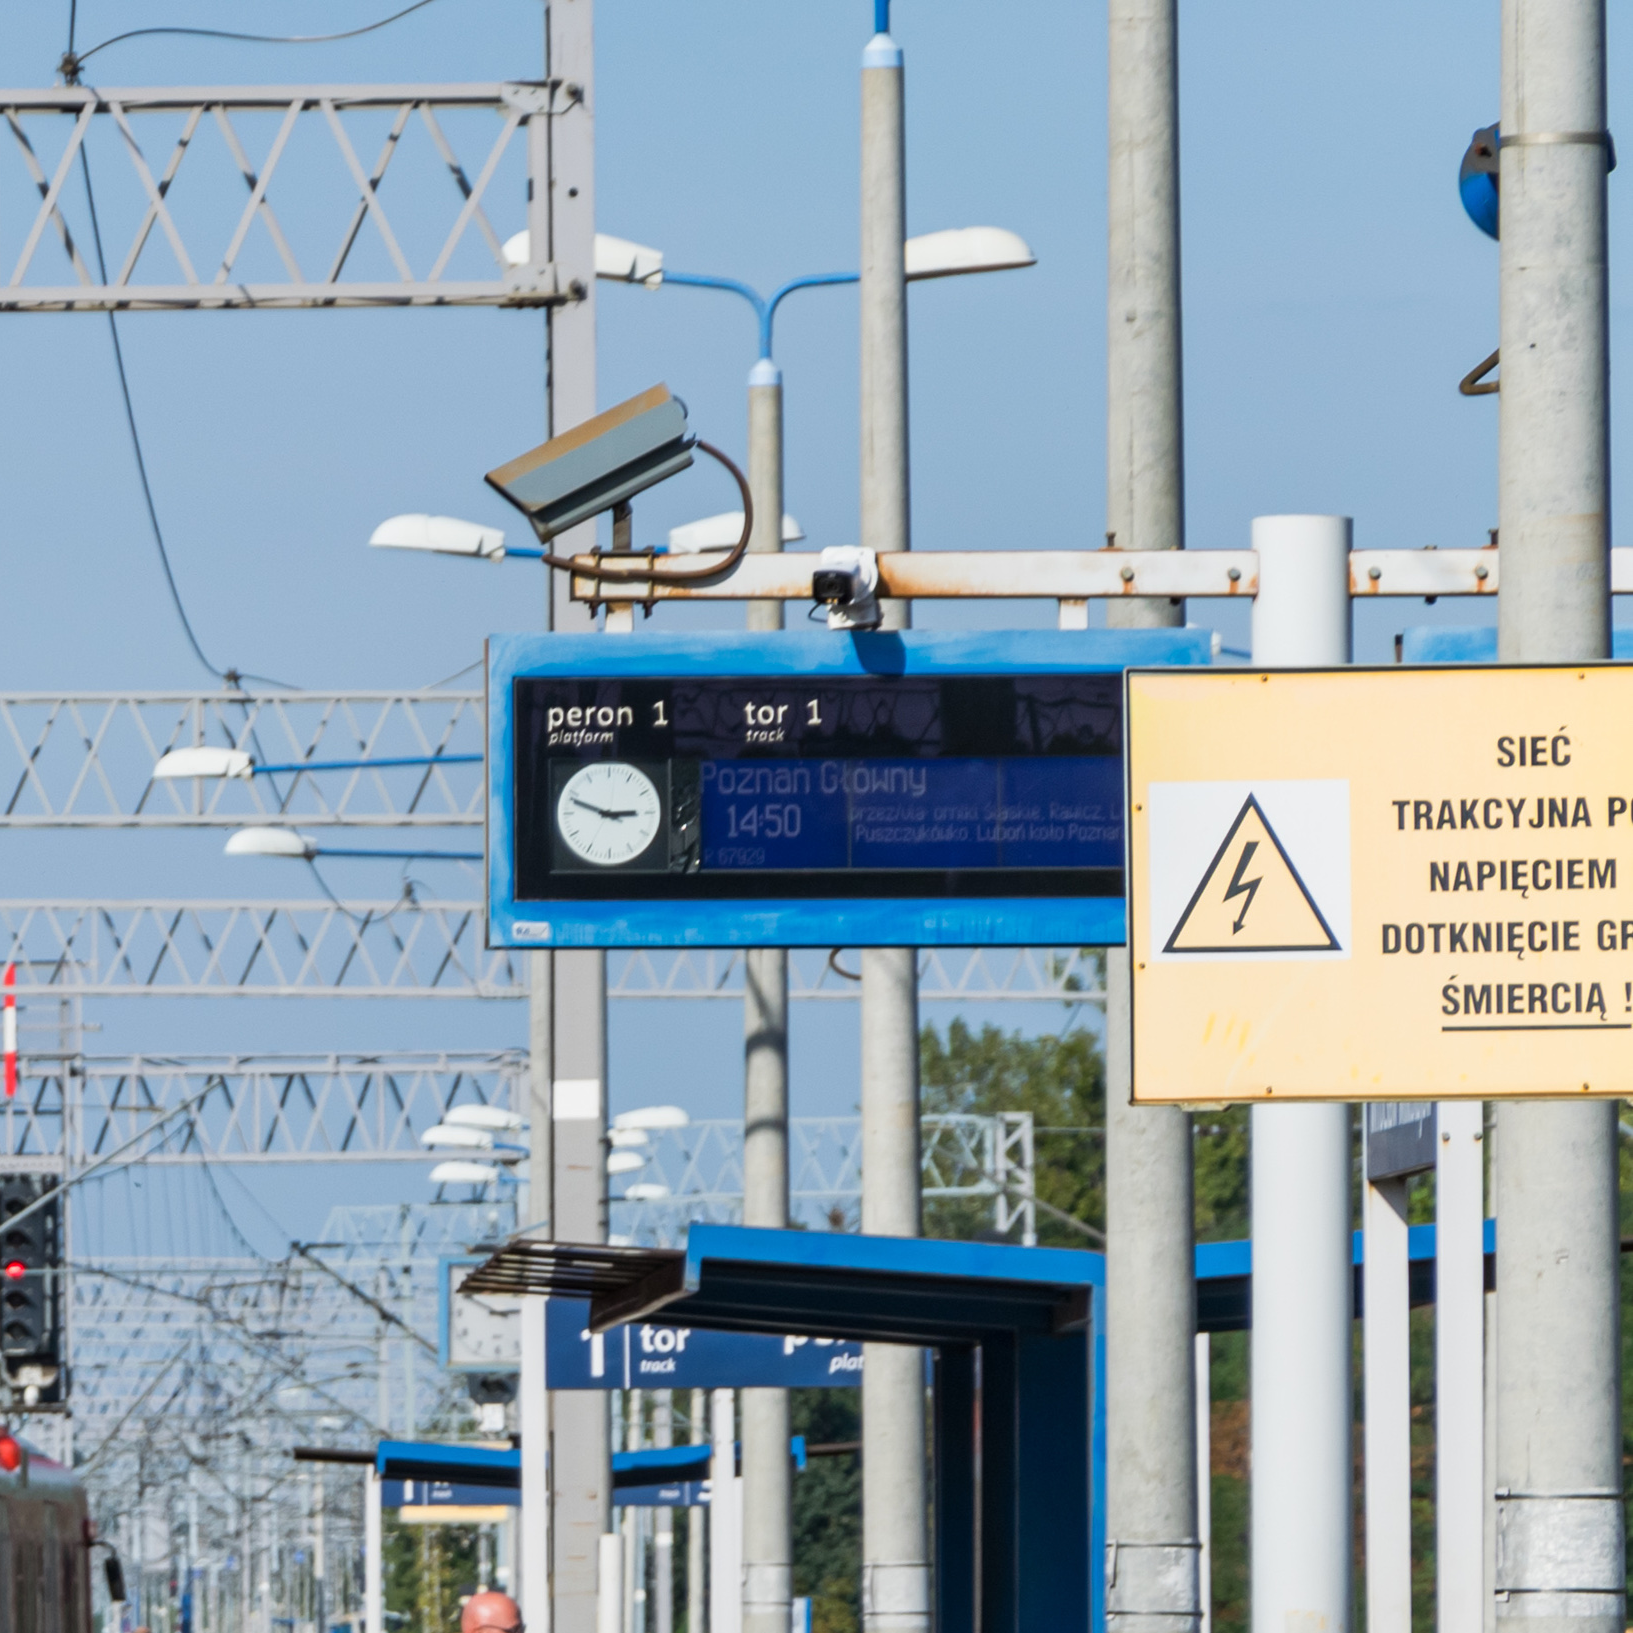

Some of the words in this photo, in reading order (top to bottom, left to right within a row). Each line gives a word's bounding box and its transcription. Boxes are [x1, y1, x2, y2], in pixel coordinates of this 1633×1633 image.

[547, 704, 634, 732] peron
[652, 700, 669, 726] 1
[743, 701, 789, 726] tor
[806, 699, 822, 726] 1
[547, 728, 615, 747] platform
[744, 728, 785, 743] track
[1496, 725, 1572, 768] SIEĆ
[699, 760, 811, 795] Poznań
[820, 760, 927, 797] Główny
[726, 803, 802, 839] 14:50
[1392, 797, 1593, 831] TRAKCYJNA
[1607, 796, 1633, 828] P
[1429, 858, 1618, 900] NAPIĘCIEM
[1381, 919, 1582, 961] DOTKNIĘCIE
[1440, 974, 1608, 1022] ŚMIERCIĄ
[639, 1322, 691, 1354] tor
[639, 1356, 677, 1374] track
[828, 1351, 865, 1375] plat
